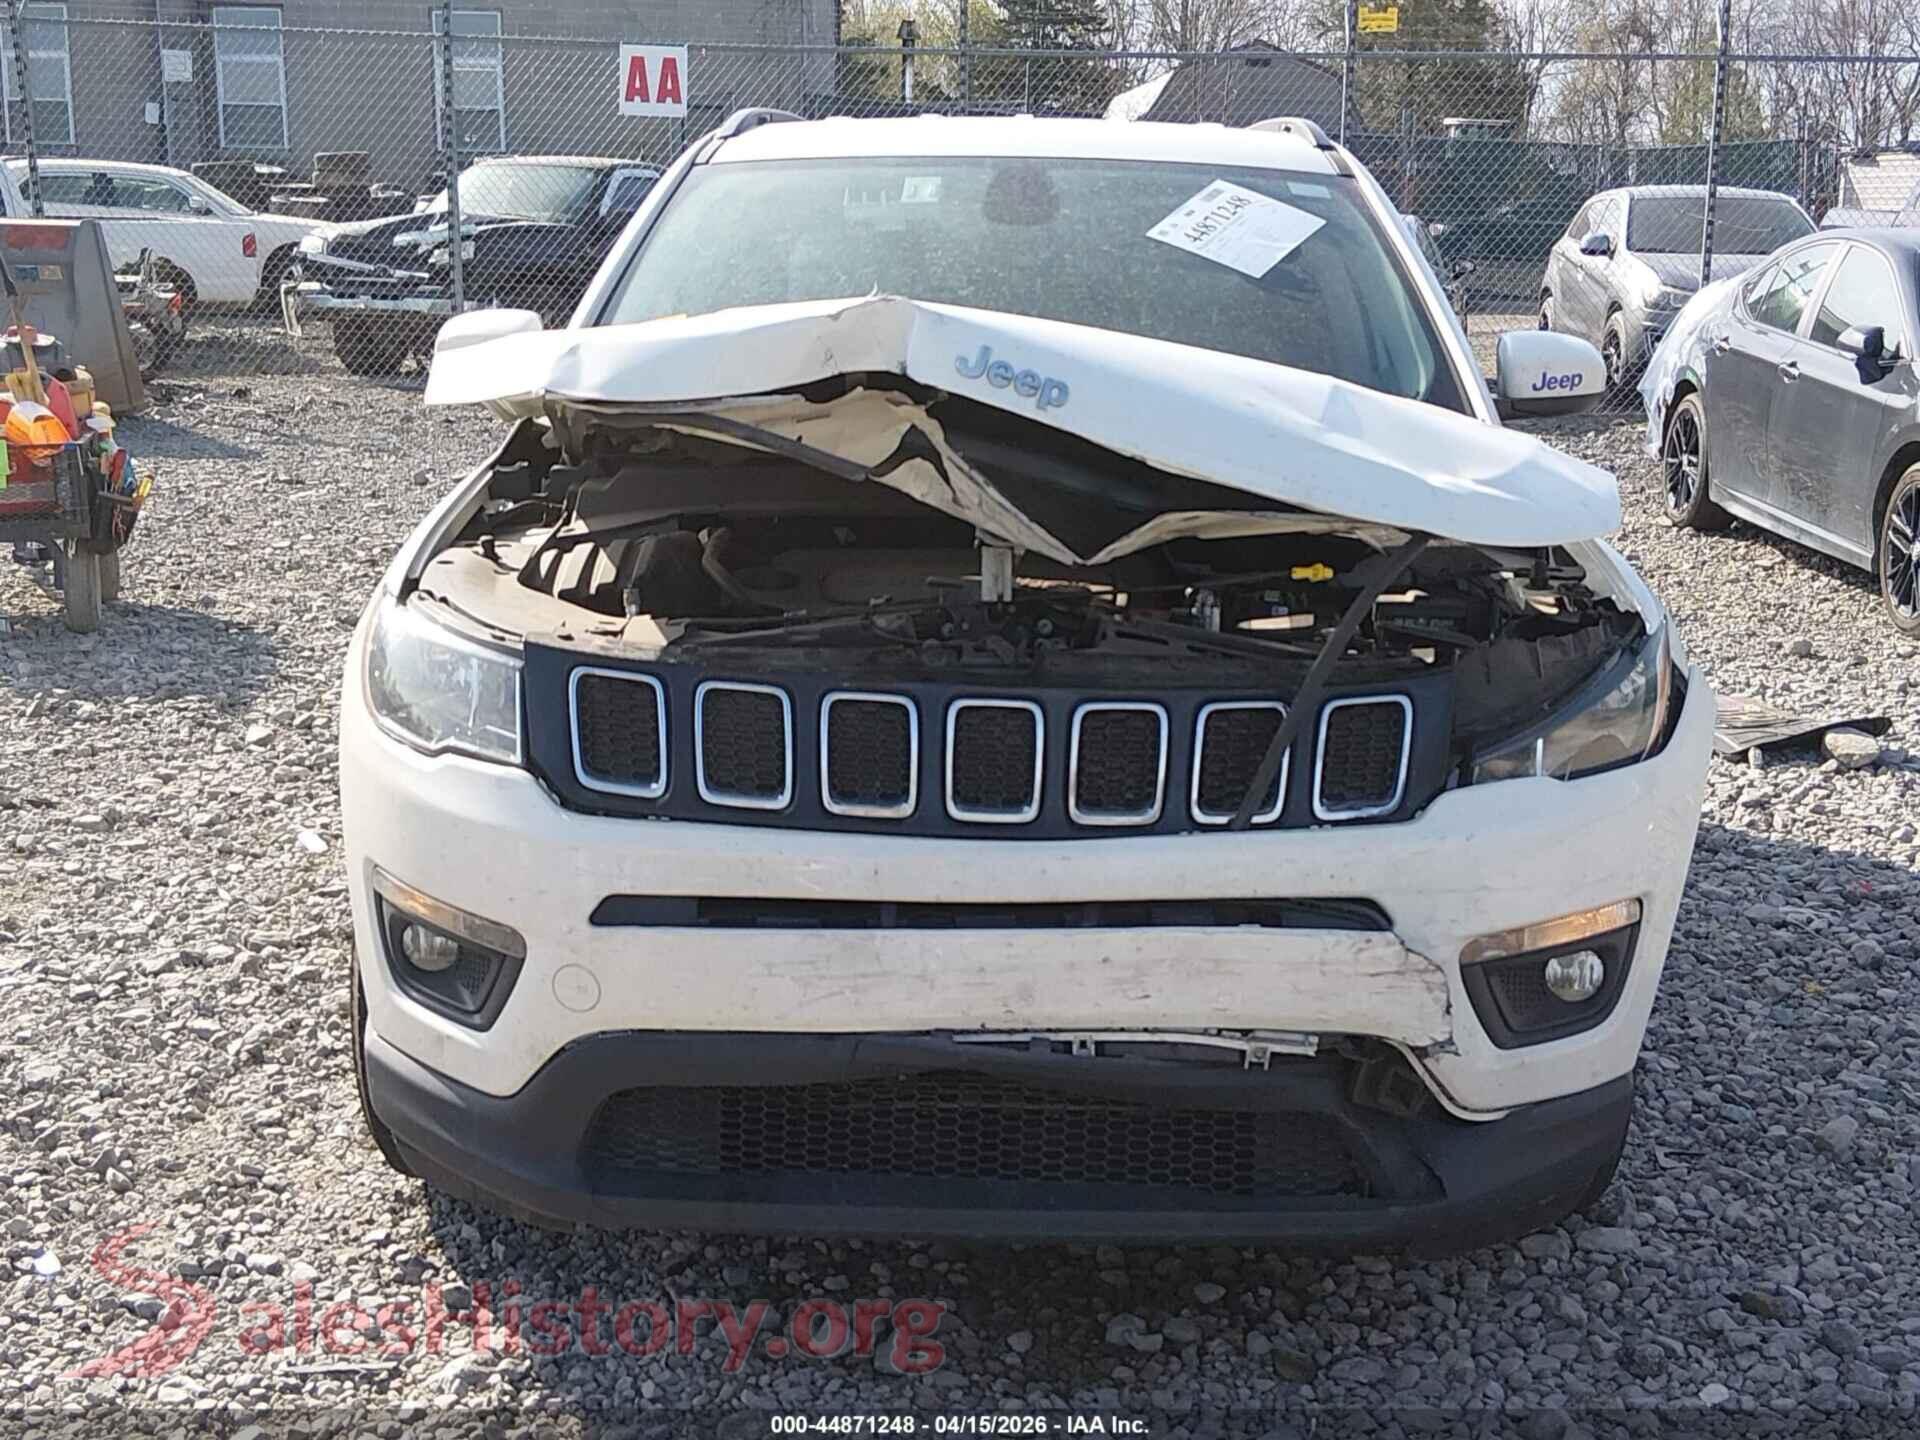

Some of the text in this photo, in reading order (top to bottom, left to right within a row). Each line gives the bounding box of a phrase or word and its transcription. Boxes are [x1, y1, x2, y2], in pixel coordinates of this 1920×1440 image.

[624, 55, 683, 105] AA
[1184, 194, 1252, 243] 44871248
[955, 344, 1070, 411] Jeep
[1532, 371, 1583, 391] Jeep
